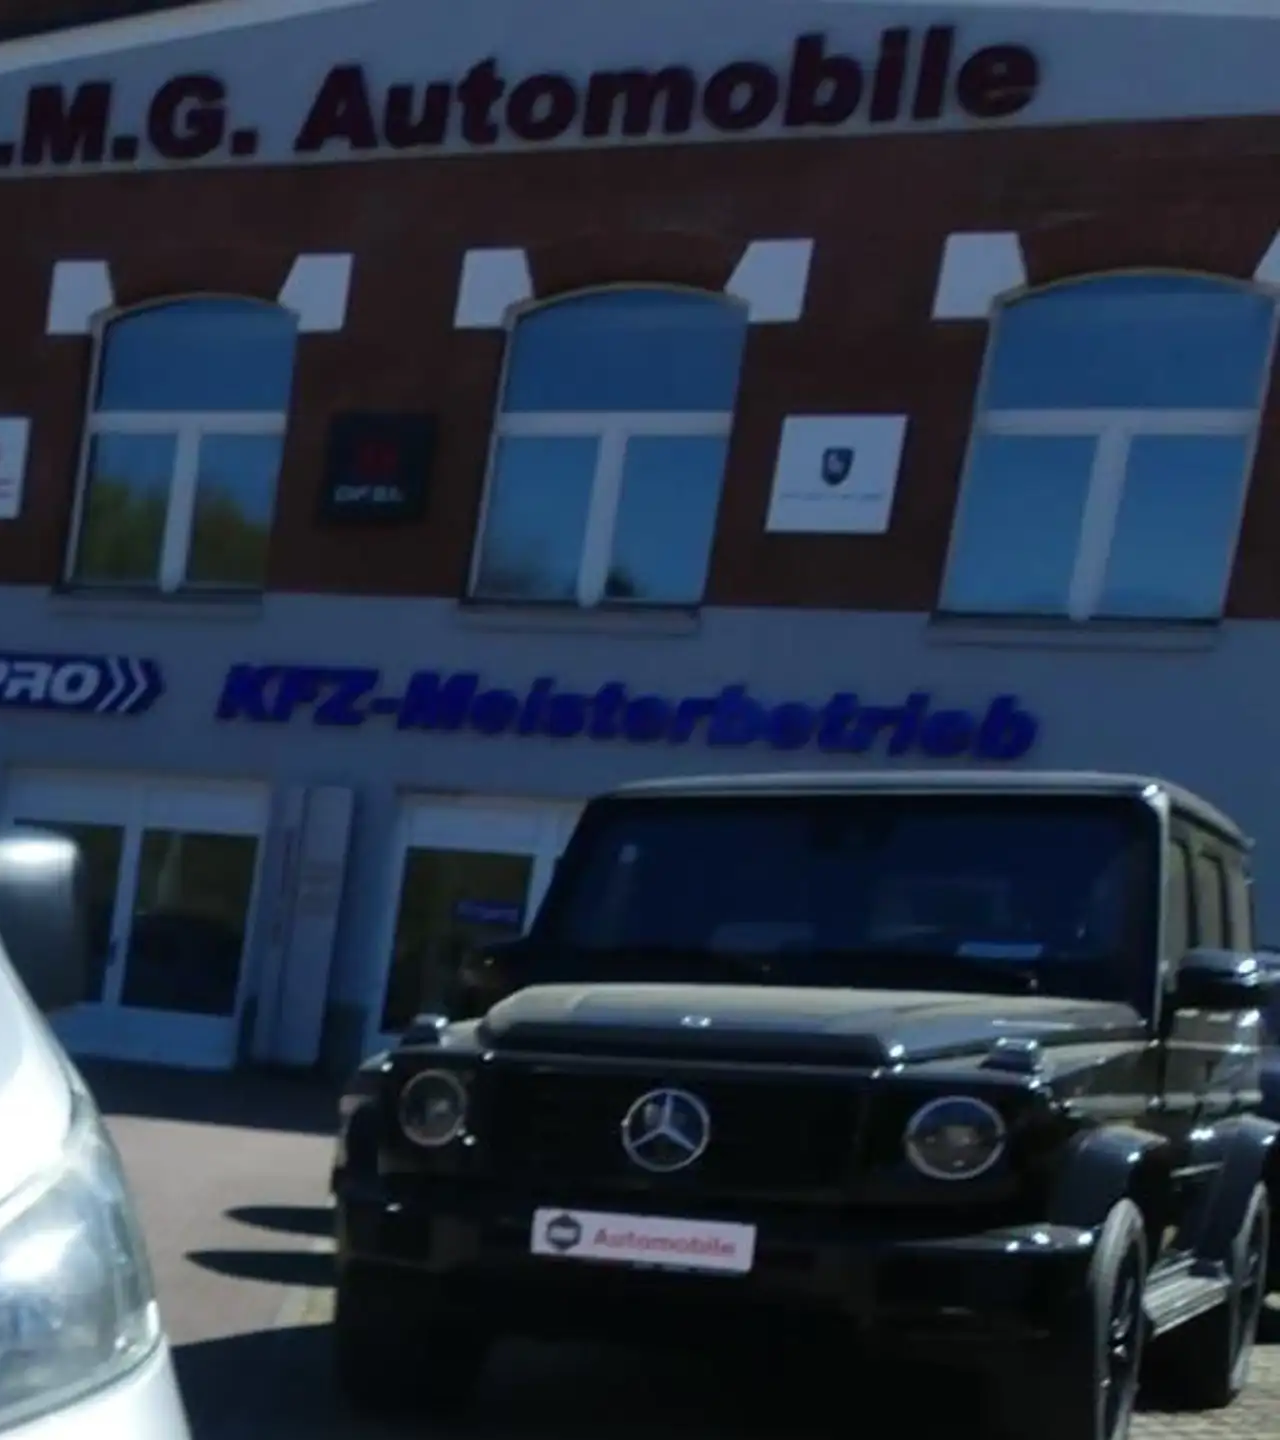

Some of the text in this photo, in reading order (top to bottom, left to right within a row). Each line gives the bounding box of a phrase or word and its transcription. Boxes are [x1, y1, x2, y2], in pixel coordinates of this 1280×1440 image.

[293, 26, 1044, 154] Automobile
[215, 662, 1038, 761] KFZ-Meisterbetrieb
[593, 1228, 737, 1257] Automobile
